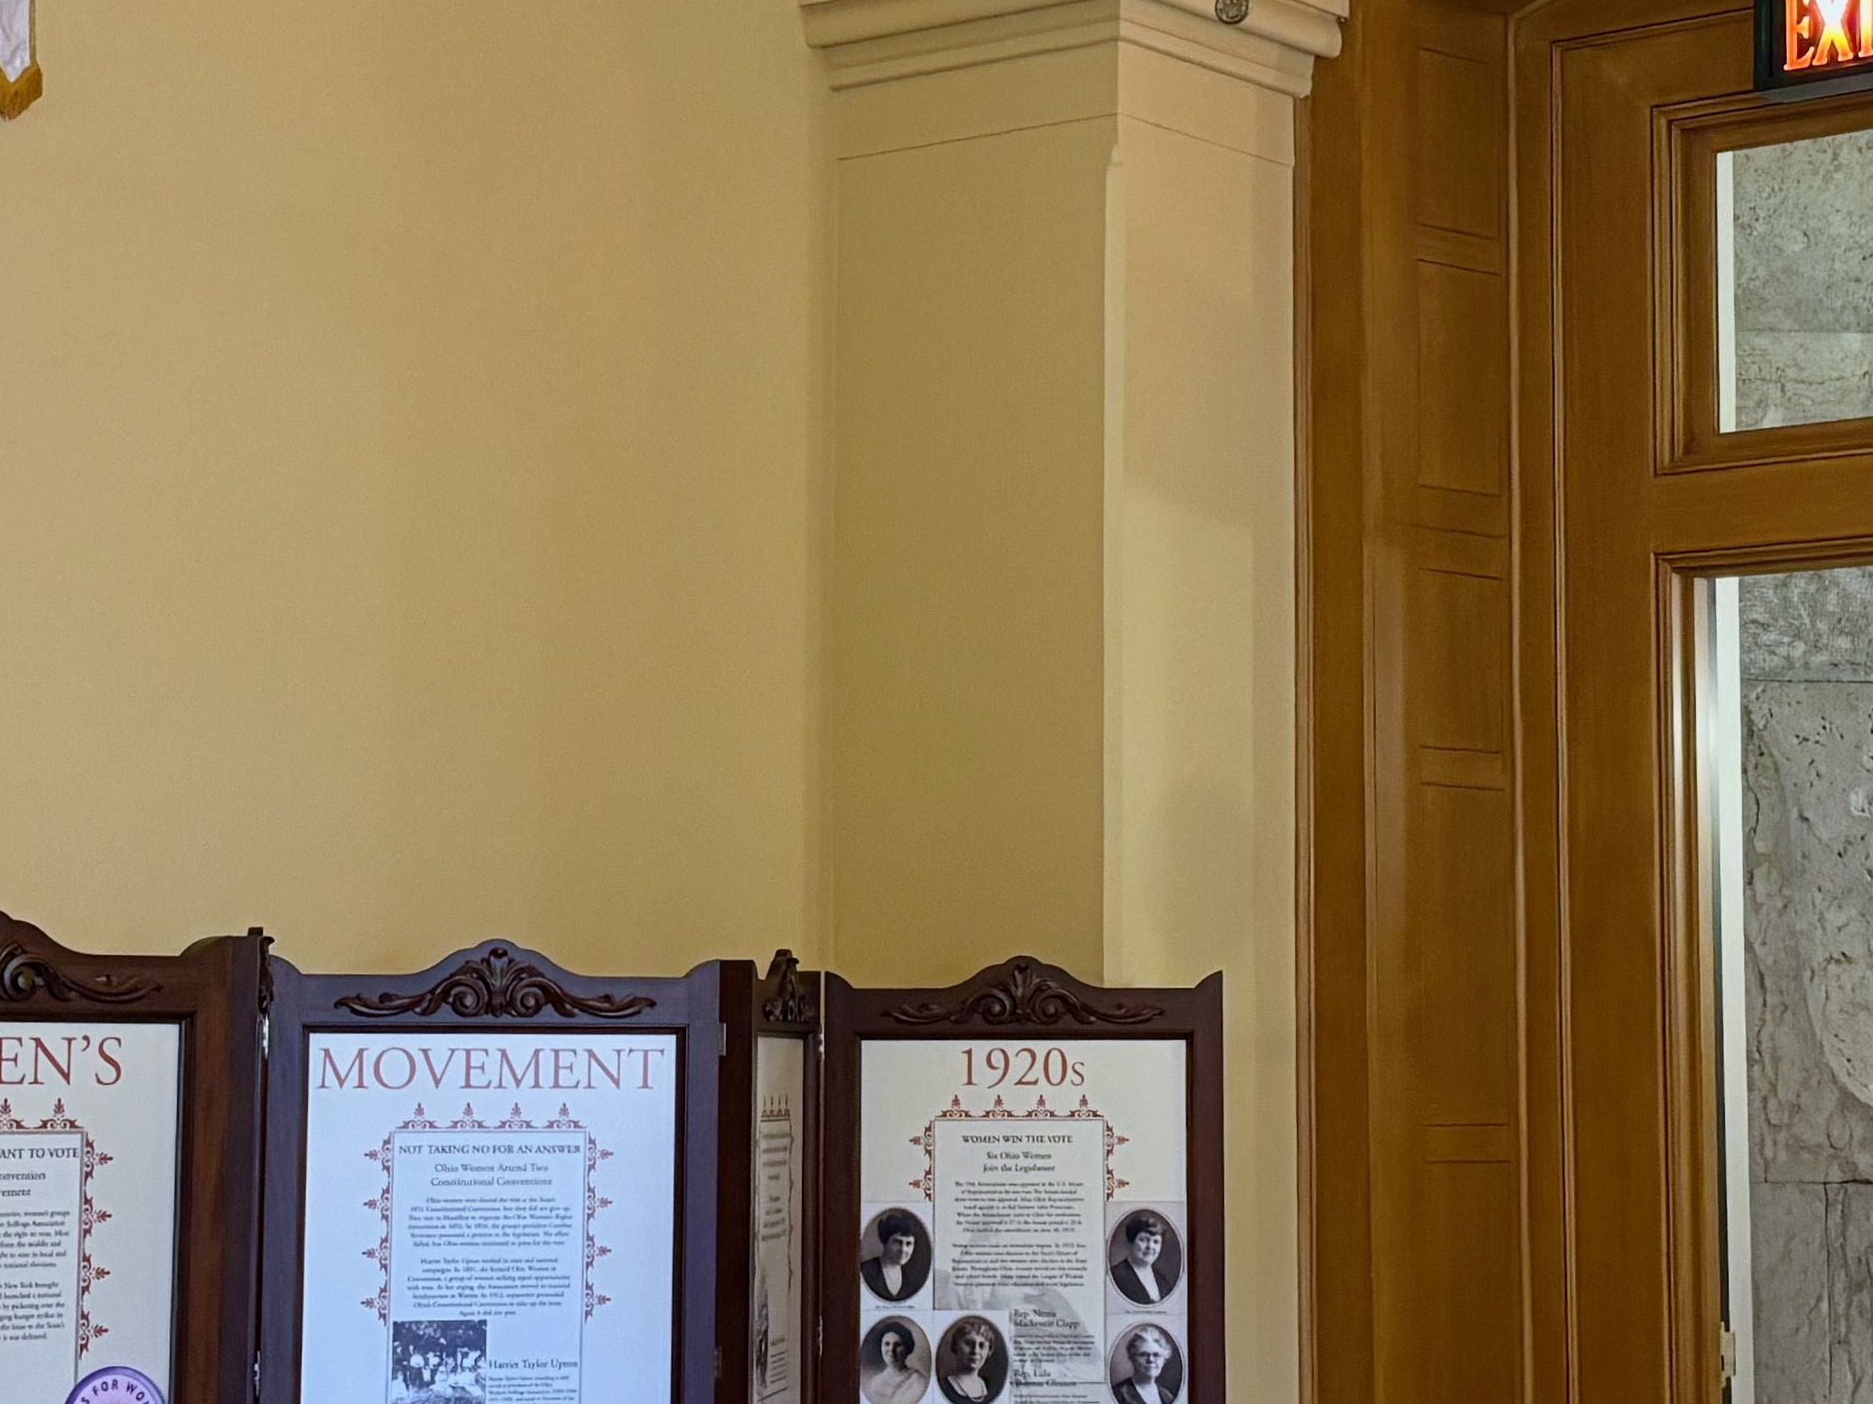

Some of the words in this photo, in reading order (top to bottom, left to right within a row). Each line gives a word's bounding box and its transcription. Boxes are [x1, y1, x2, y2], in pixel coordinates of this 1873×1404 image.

[316, 1047, 665, 1090] MOVEMENT
[961, 1047, 1085, 1089] 1920s
[961, 1135, 1000, 1144] WOMEN
[1002, 1135, 1023, 1144] WIN
[1027, 1135, 1046, 1144] THE
[1047, 1135, 1073, 1144] VOTE
[28, 1148, 45, 1158] TO
[47, 1147, 78, 1158] VOTE
[399, 1145, 423, 1154] NOT
[428, 1145, 470, 1154] TAKING
[472, 1145, 490, 1154] NO
[492, 1145, 514, 1154] FOR
[516, 1145, 534, 1154] AN
[534, 1145, 581, 1154] ANSWER
[92, 1379, 119, 1396] FOR
